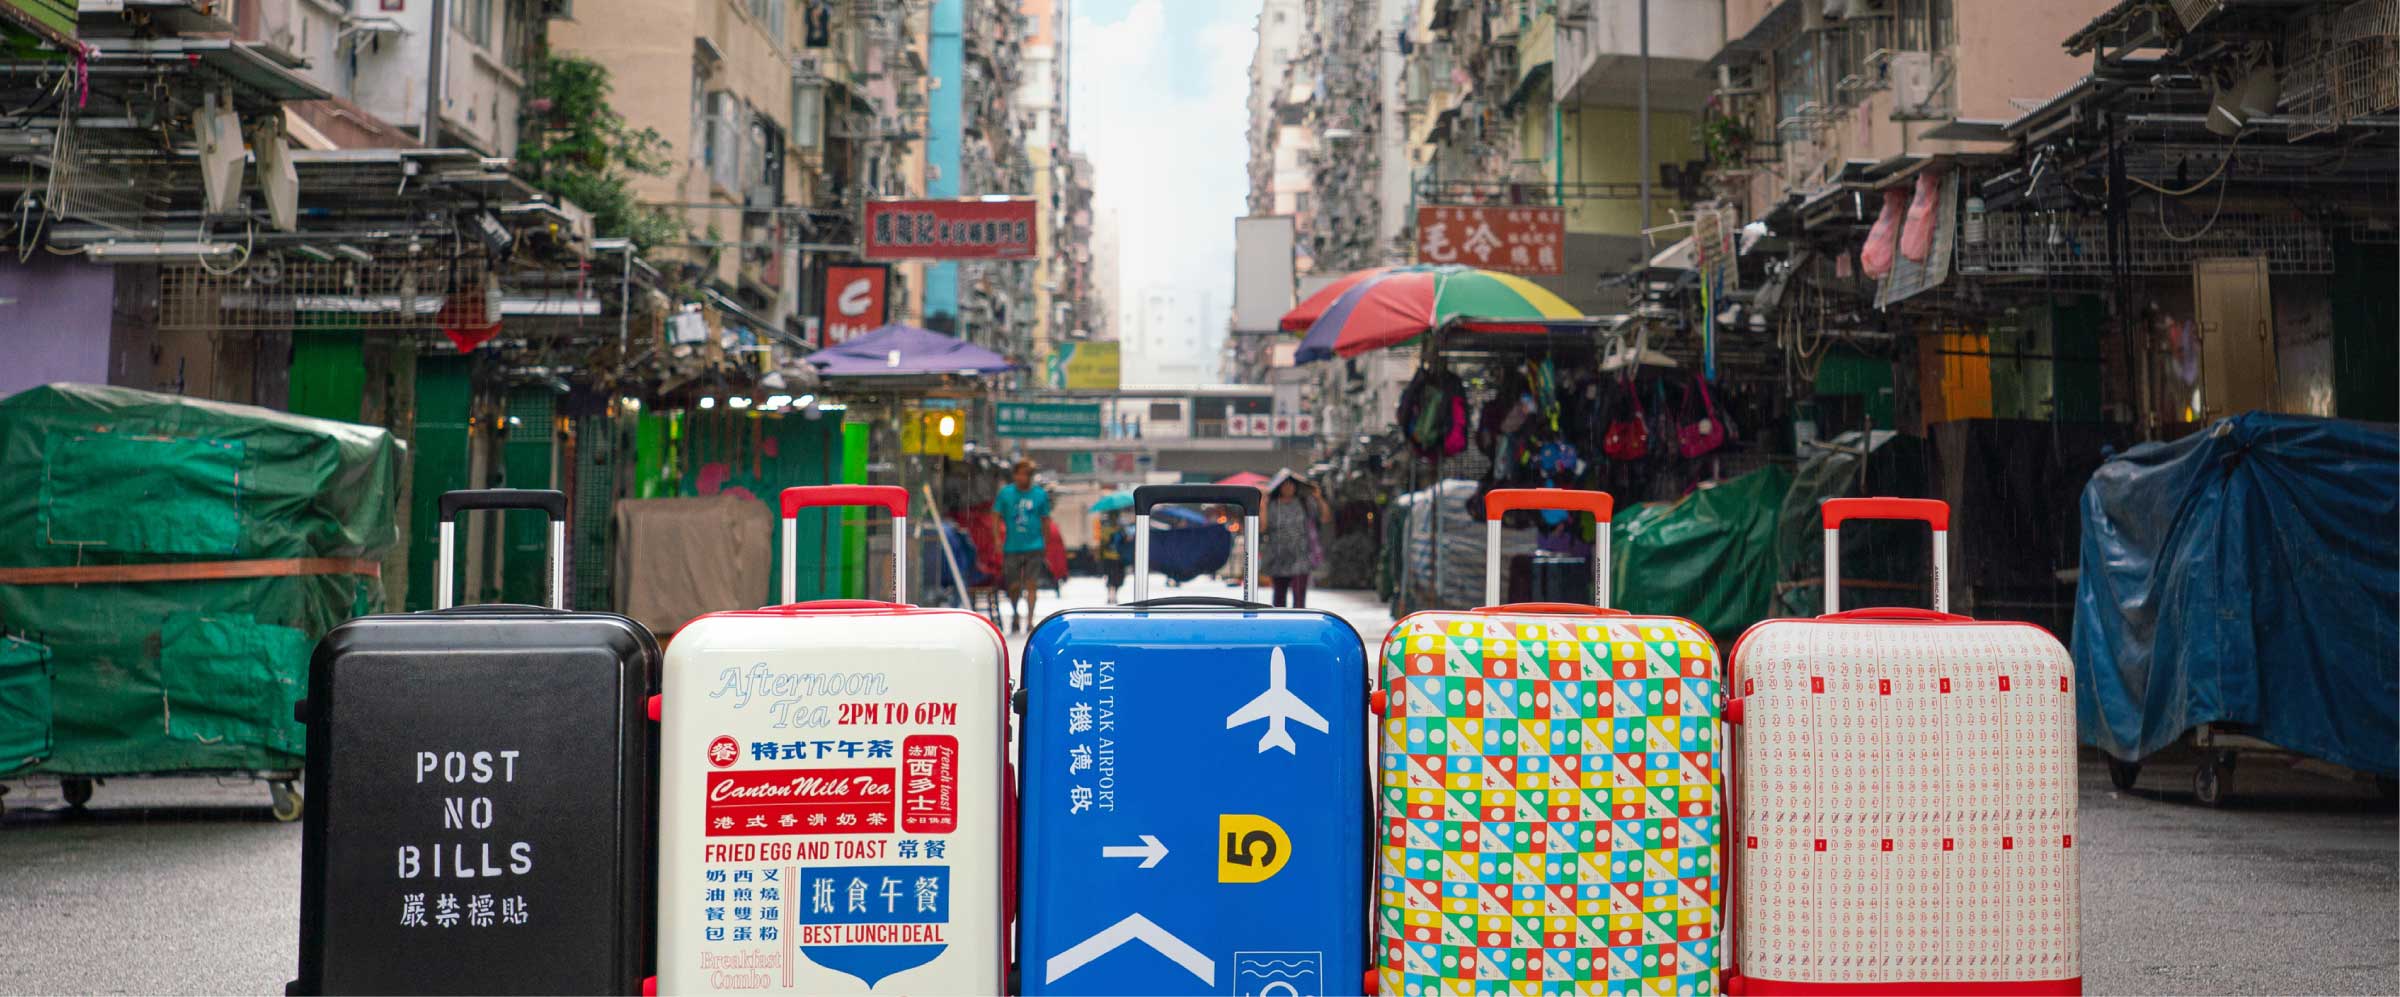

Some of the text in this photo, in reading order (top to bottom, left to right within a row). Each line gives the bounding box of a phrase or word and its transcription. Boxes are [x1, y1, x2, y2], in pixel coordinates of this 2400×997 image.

[1421, 222, 1503, 263] 毛冷
[709, 662, 888, 709] Afternoon
[769, 695, 830, 728] Tea
[838, 702, 957, 725] 2PM TO 6PM
[710, 742, 736, 762] 餐
[751, 739, 894, 761] 特式下午茶
[1099, 661, 1115, 812] KAI TAK AIRPORT
[416, 750, 520, 784] POST
[939, 744, 954, 811] french toast
[711, 776, 891, 802] Canton Milk Tea
[444, 797, 493, 830] NO
[713, 812, 888, 829] 港式香滑奶茶
[398, 841, 532, 878] BILLS
[705, 840, 887, 863] FRIED EGG AND TOAST
[898, 839, 945, 859] 常餐
[1227, 830, 1277, 868] 5
[399, 893, 530, 928] 嚴禁標貼
[812, 875, 939, 914] 抵食午餐
[803, 924, 944, 944] BEST LUNCH DEAL
[700, 948, 782, 969] Breakfast
[711, 969, 771, 990] Combo
